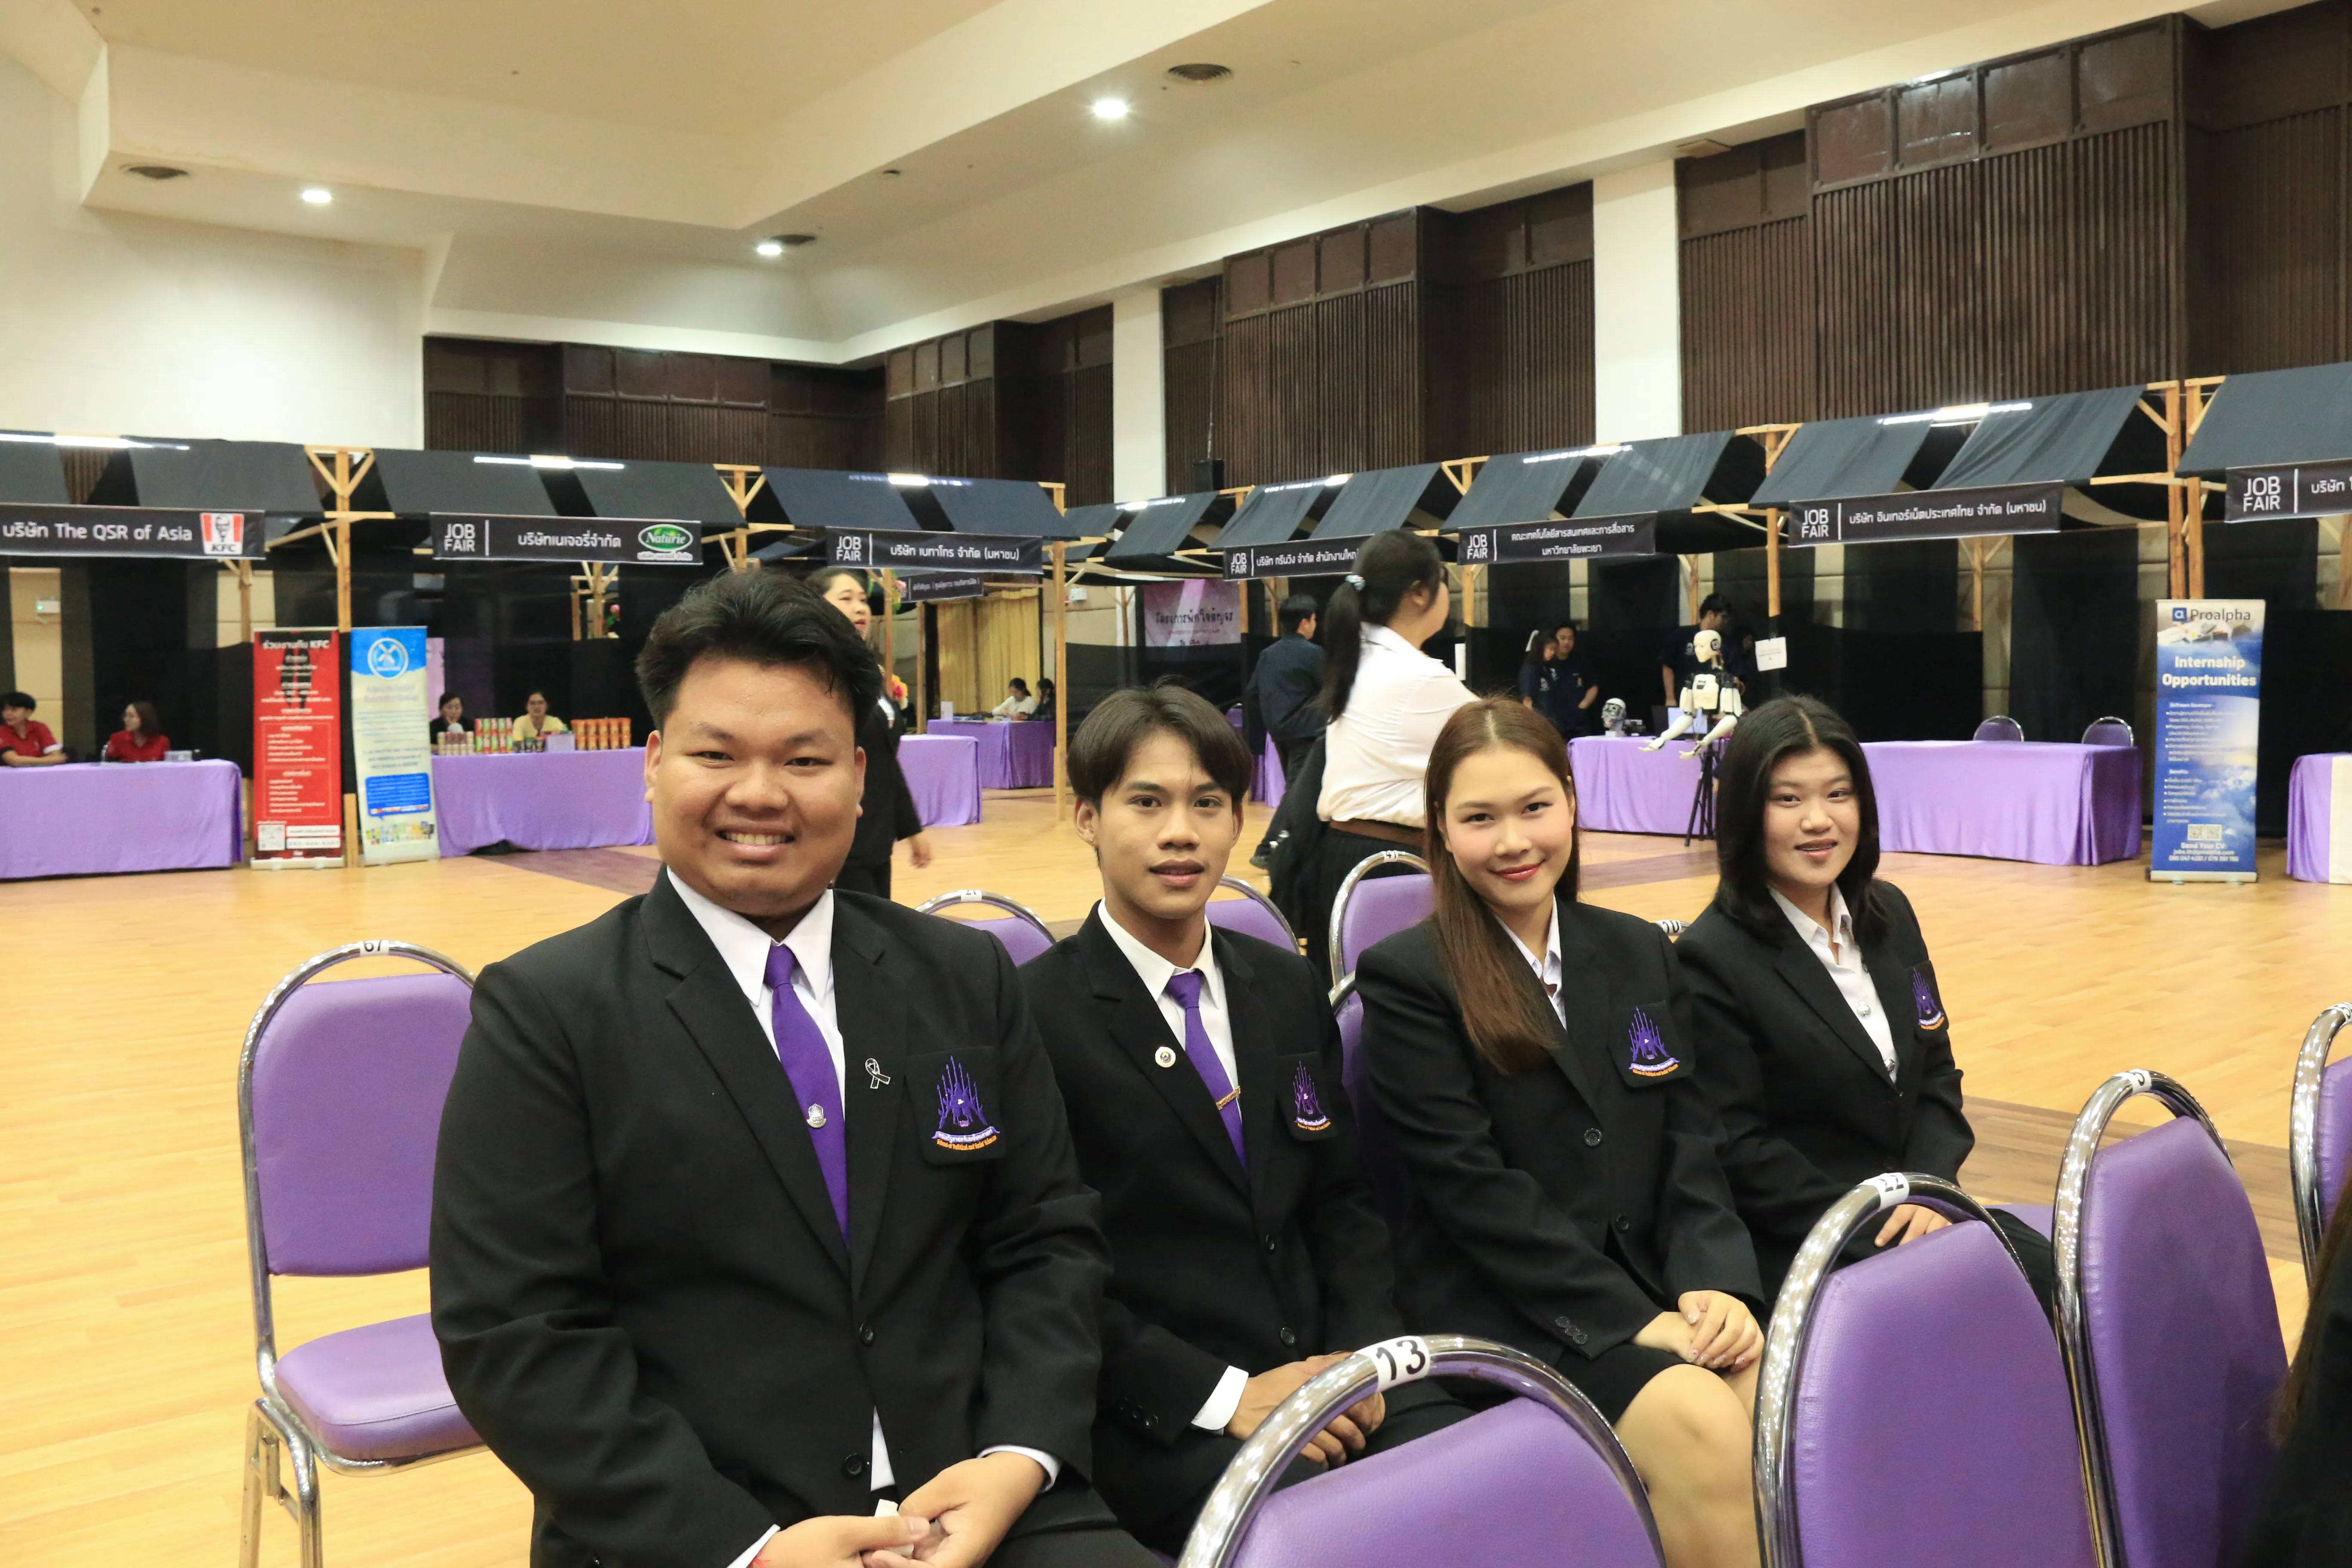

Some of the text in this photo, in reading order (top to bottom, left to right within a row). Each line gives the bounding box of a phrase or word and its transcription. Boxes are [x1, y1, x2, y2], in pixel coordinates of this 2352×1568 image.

[2243, 475, 2281, 497] JOB
[2311, 478, 2346, 494] บริษัท
[2243, 495, 2281, 512] FAIR
[1802, 508, 1829, 525] JOB
[1849, 512, 1874, 524] บริษัท
[1977, 503, 2003, 516] จำกัด
[2006, 499, 2046, 515] (มหาชน)
[2, 521, 193, 542] บริษัท The QSR of Asia
[444, 523, 476, 539] JOB
[646, 532, 686, 545] Naturie
[1801, 524, 1829, 538] FAIR
[211, 543, 236, 552] KFC
[444, 538, 476, 552] FAIR
[836, 536, 862, 551] JOB
[1467, 534, 1488, 549] JOB
[836, 549, 862, 562] FAIR
[890, 544, 916, 556] บริษัท
[957, 546, 981, 558] จำกัด
[984, 547, 1020, 560] (มหาชน)
[1231, 552, 1246, 565] JOB
[1256, 555, 1274, 567] บริษัท
[1297, 552, 1314, 564] จำกัด
[1467, 547, 1488, 560] FAIR
[1230, 564, 1246, 575] FAIR
[2190, 609, 2251, 622] Proalpha
[309, 640, 330, 649] KFC
[2174, 655, 2246, 670] Internship
[2162, 674, 2257, 689] Opportunities
[1375, 1339, 1426, 1381] 13
